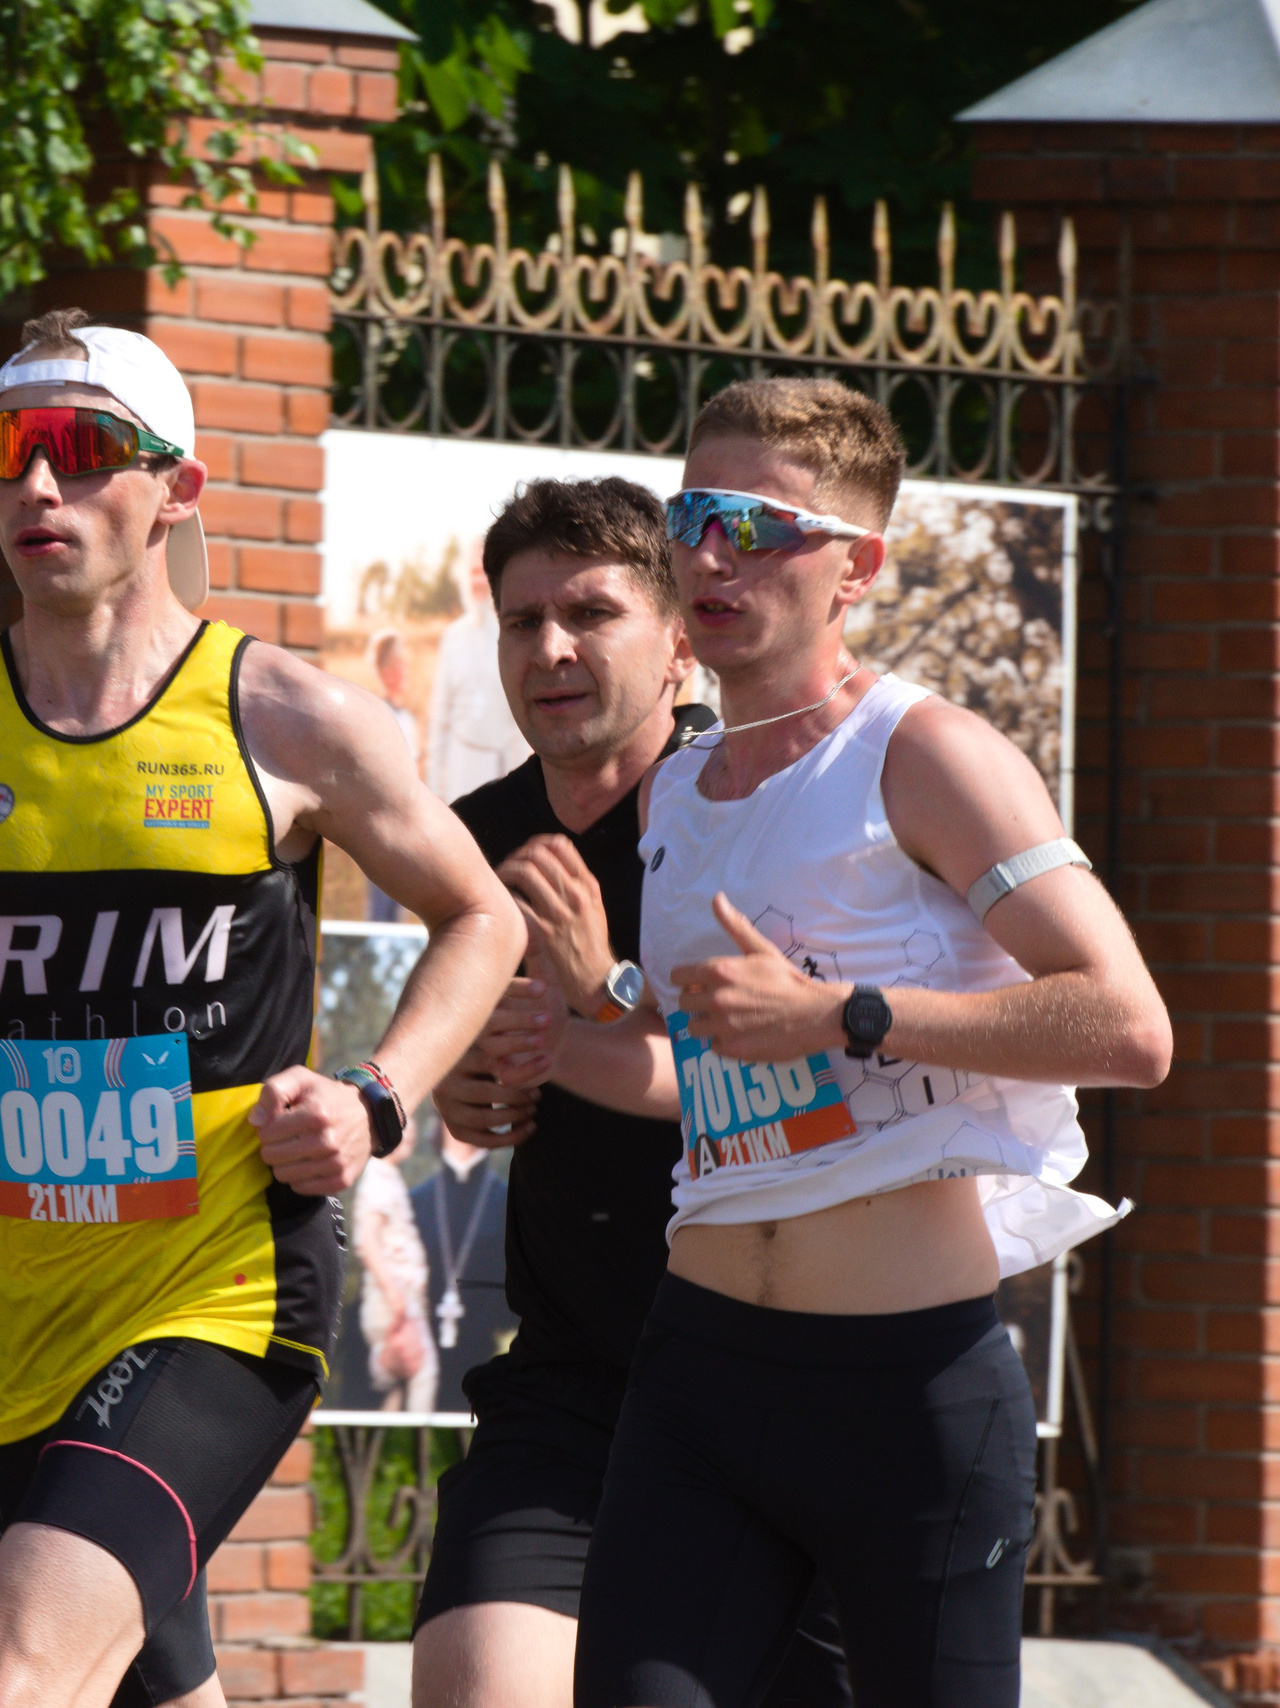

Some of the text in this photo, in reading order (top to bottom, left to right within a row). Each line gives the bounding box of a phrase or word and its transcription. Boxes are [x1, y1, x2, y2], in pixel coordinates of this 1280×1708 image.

[137, 761, 224, 776] RUN365.RU
[146, 784, 213, 799] MY SPORT
[144, 798, 214, 819] EXPERT
[42, 1047, 81, 1084] 10
[698, 1136, 718, 1178] A
[28, 1183, 119, 1223] 21.1KM
